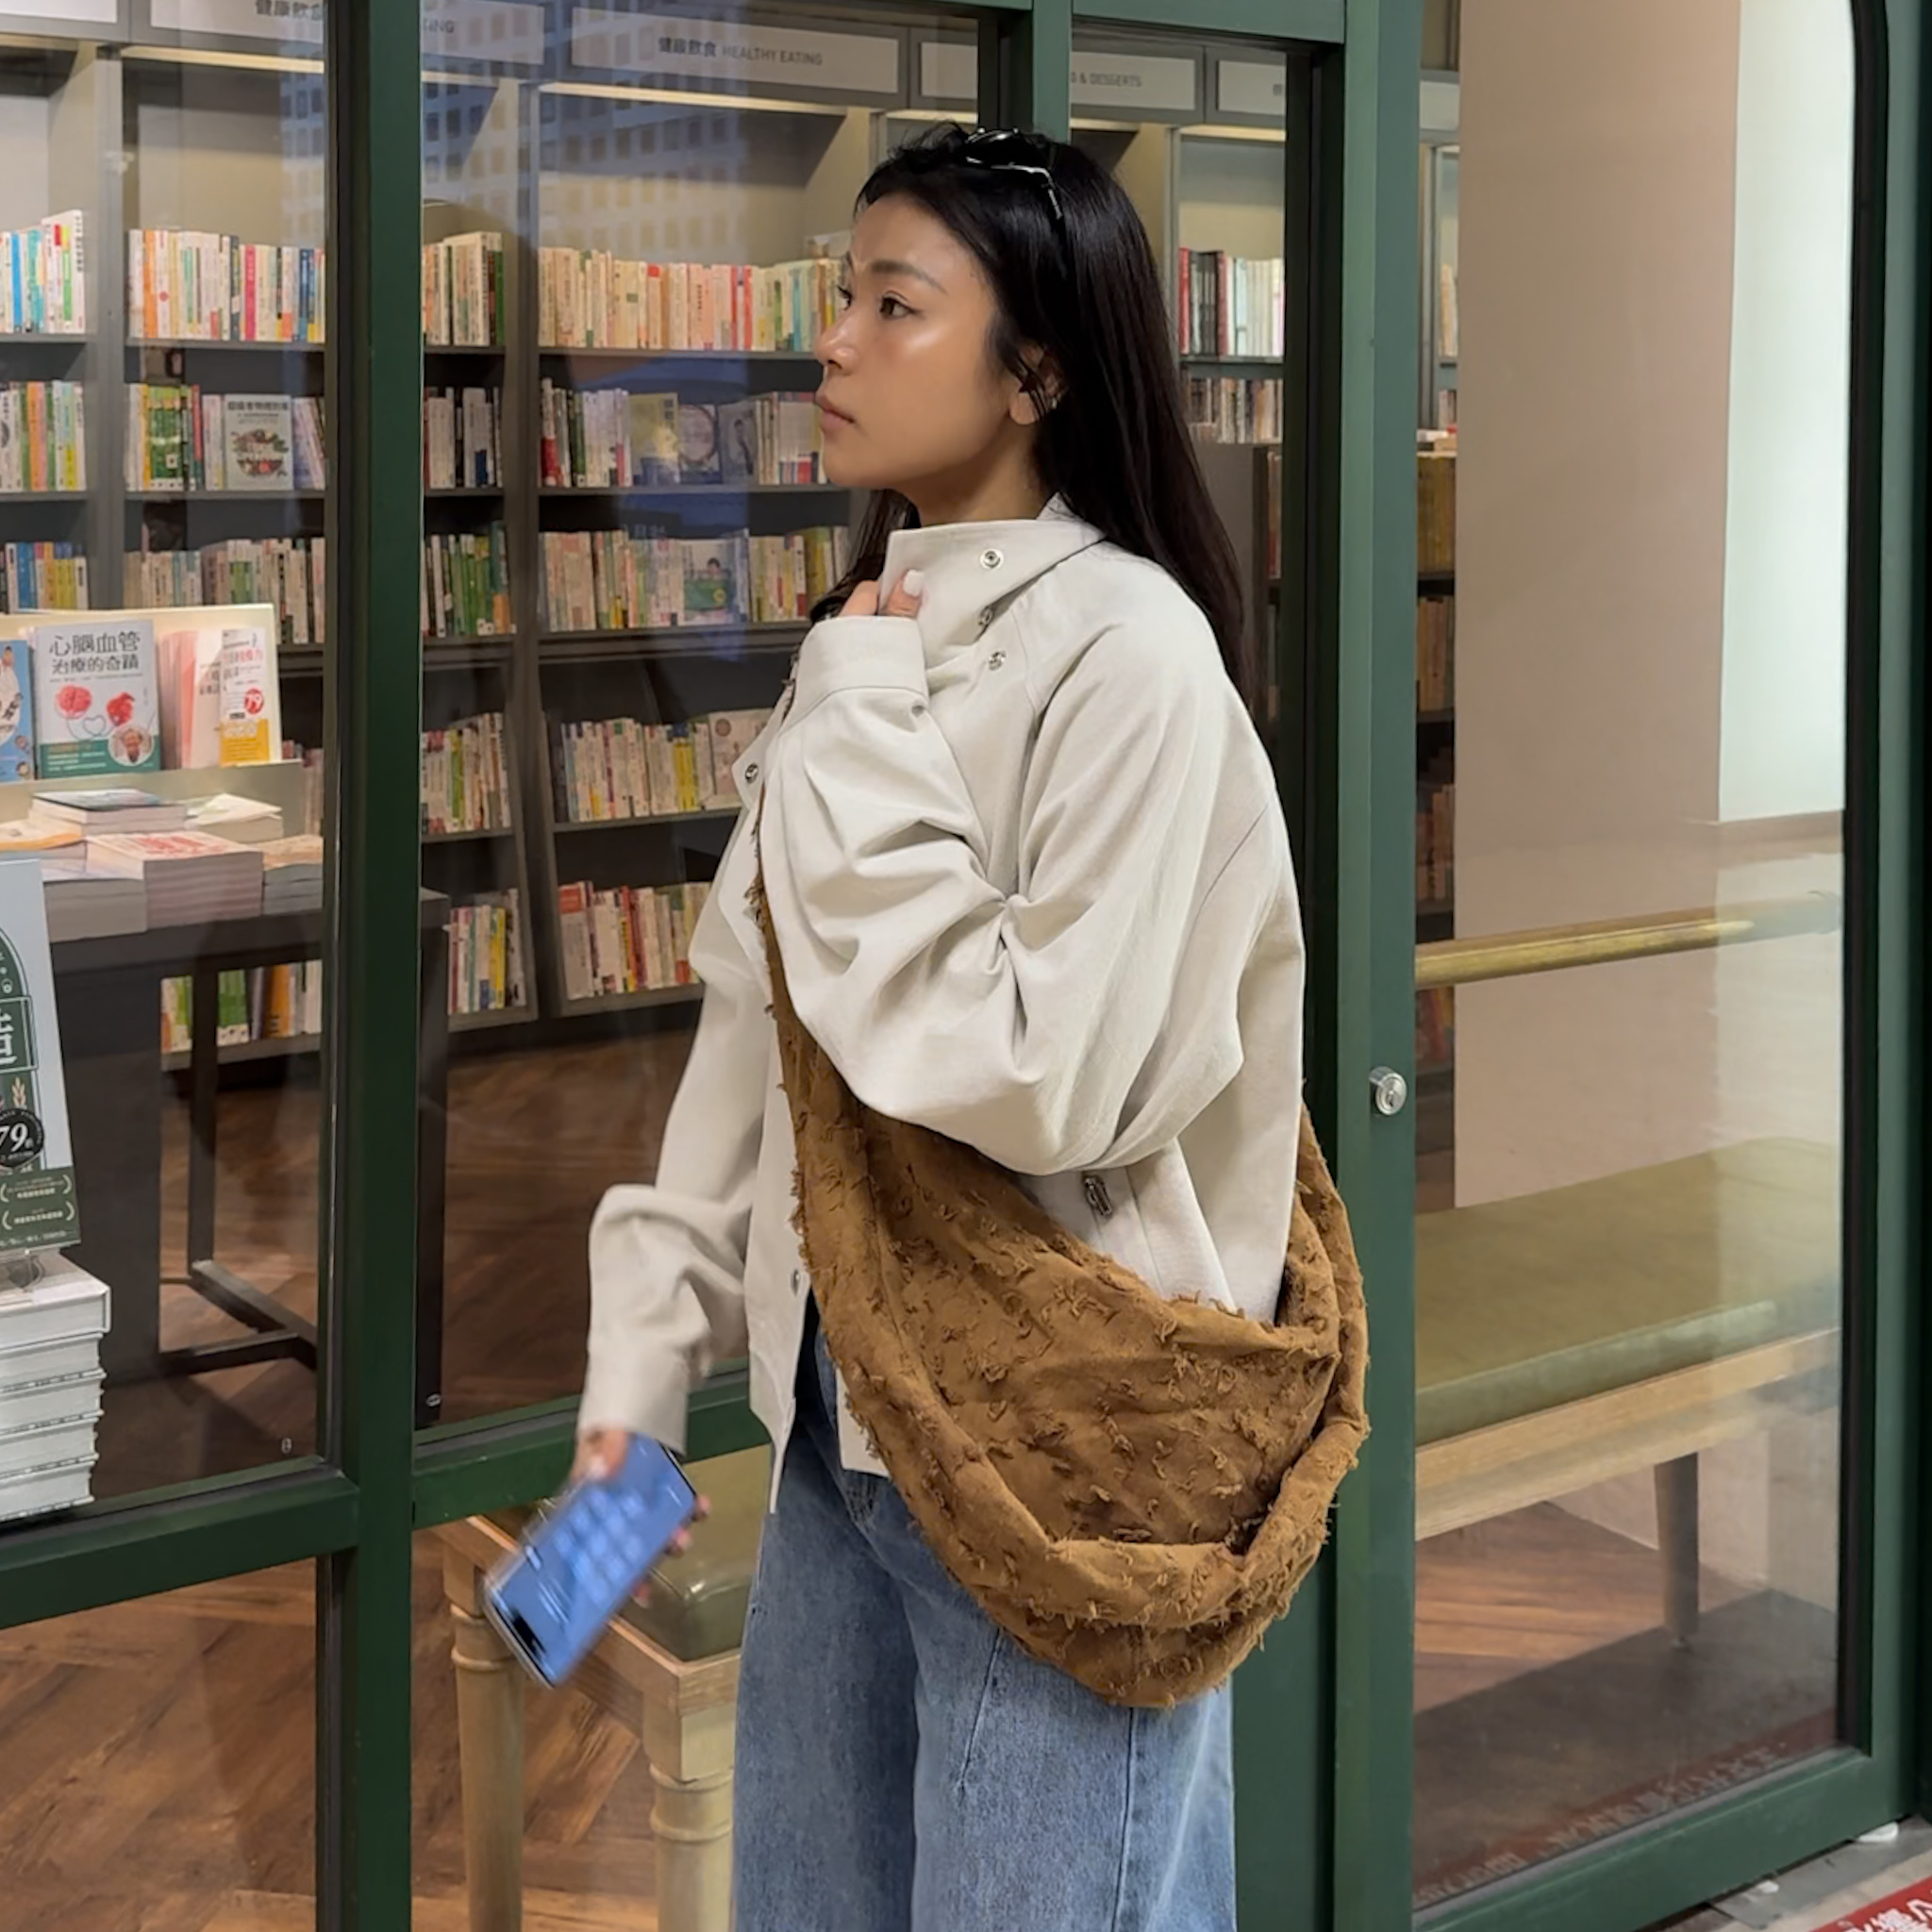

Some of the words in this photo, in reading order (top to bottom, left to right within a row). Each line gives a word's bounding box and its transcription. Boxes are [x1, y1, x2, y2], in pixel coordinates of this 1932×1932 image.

[723, 45, 776, 61] HEALTHY
[780, 50, 823, 66] EATING
[1090, 73, 1142, 87] DESSERTS
[49, 630, 141, 657] 心腦血管
[52, 654, 139, 675] 治療的奇蹟
